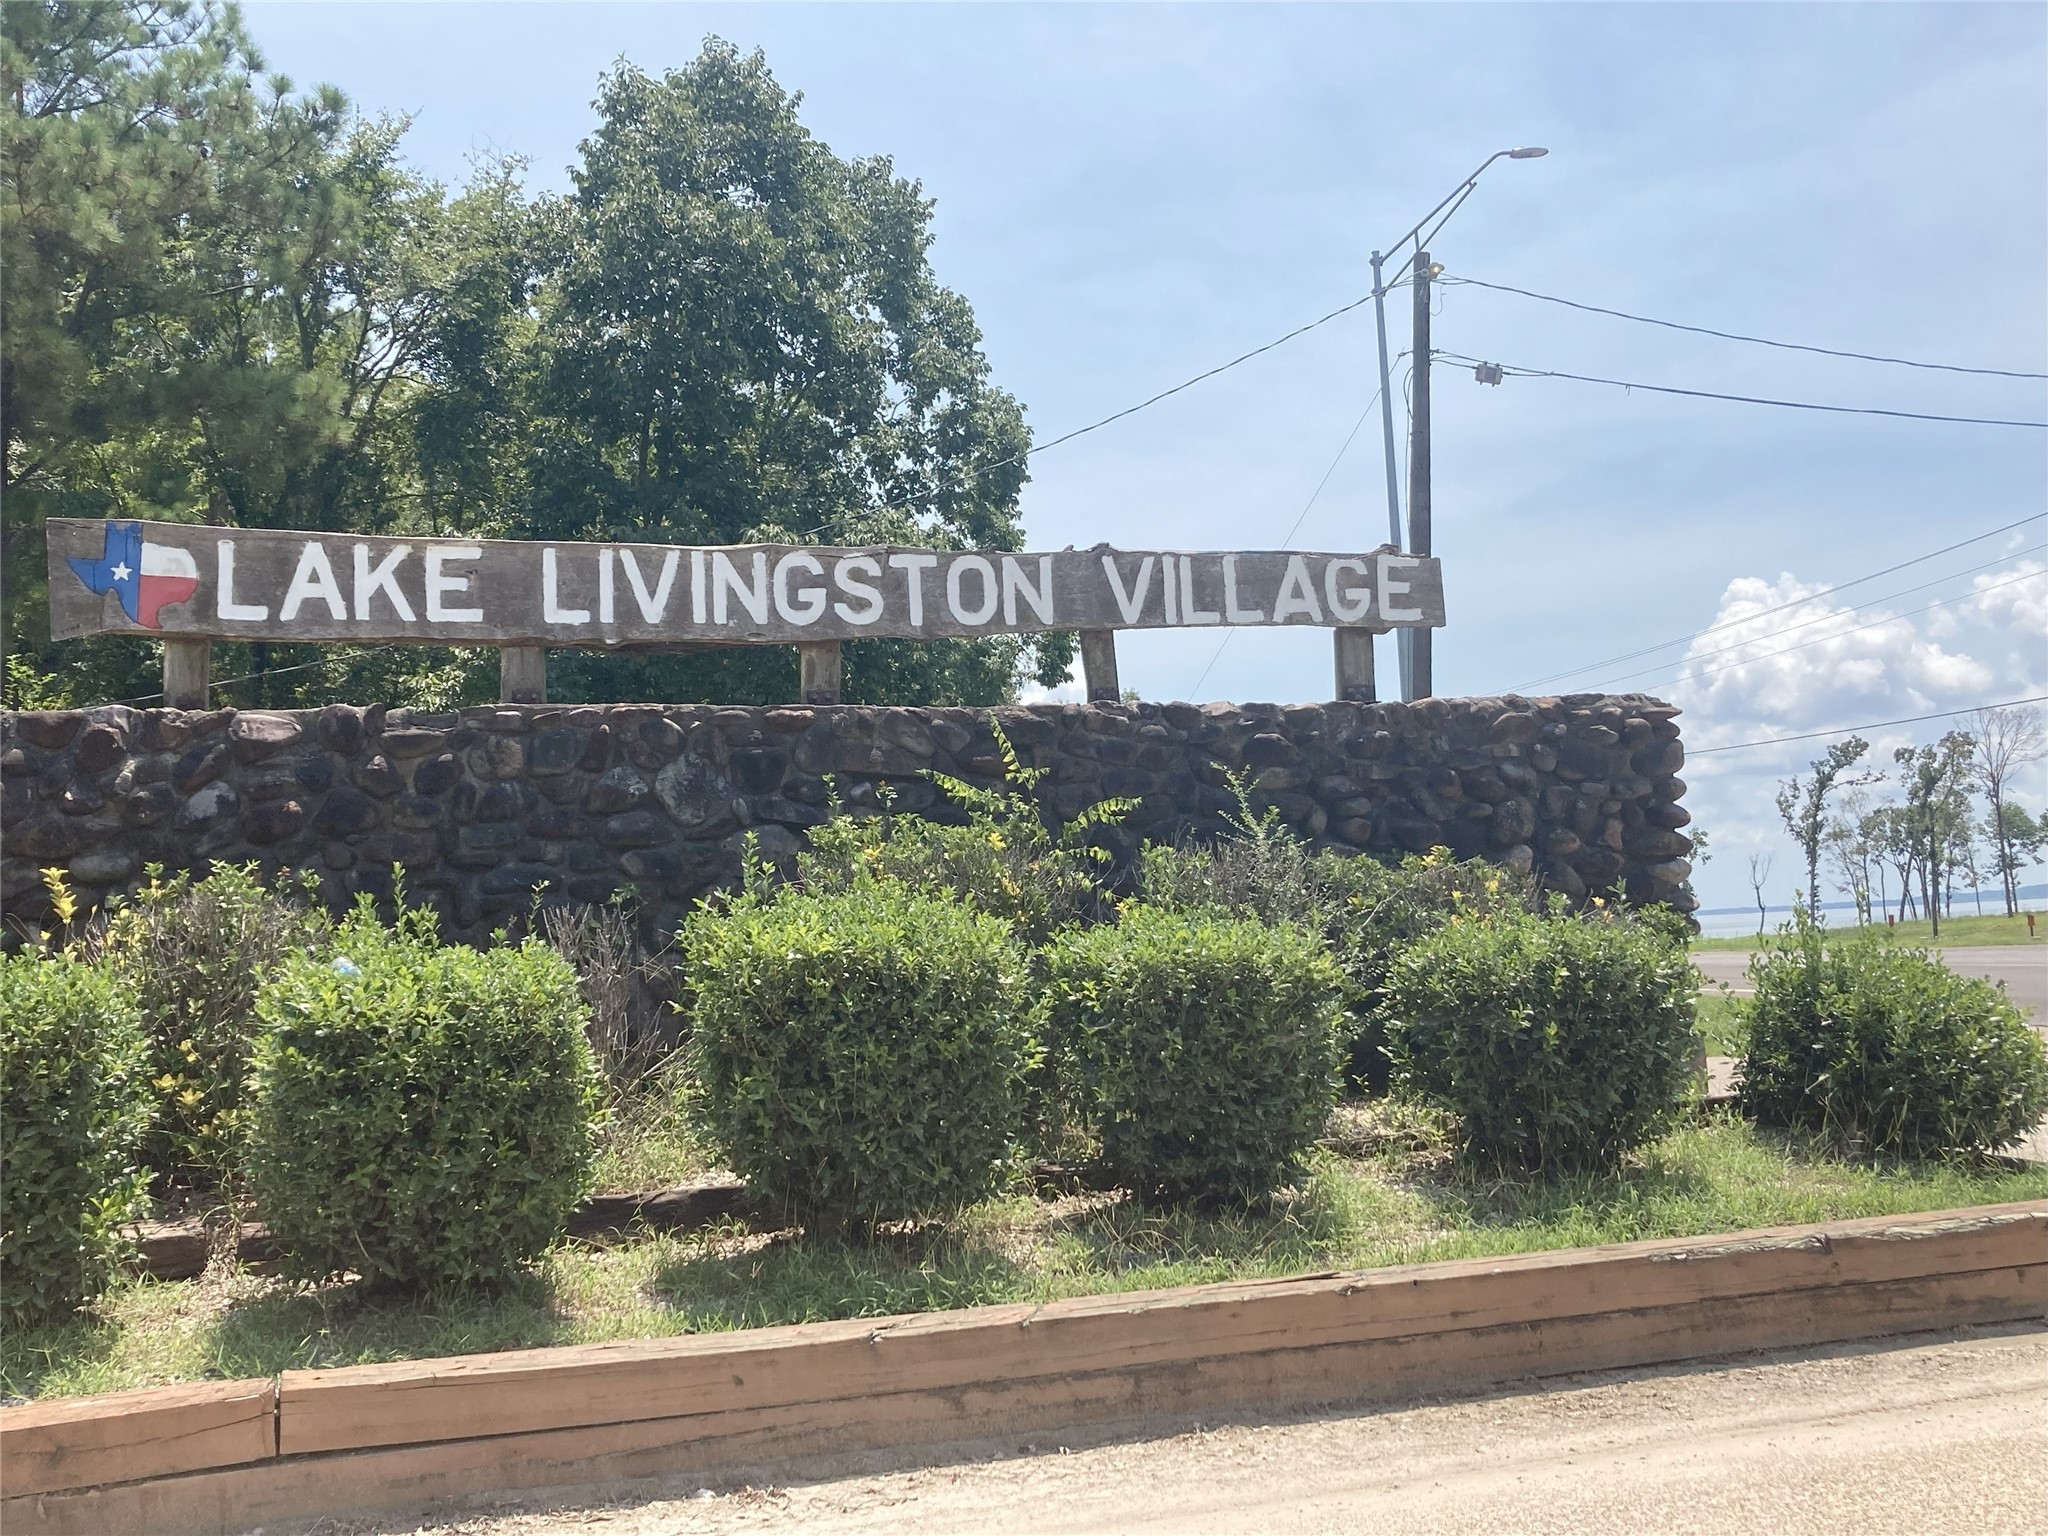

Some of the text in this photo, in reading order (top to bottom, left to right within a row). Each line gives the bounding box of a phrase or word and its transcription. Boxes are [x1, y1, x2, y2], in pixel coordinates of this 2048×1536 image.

[217, 540, 1424, 627] LAKE LIVINGSTON VILLAGE
